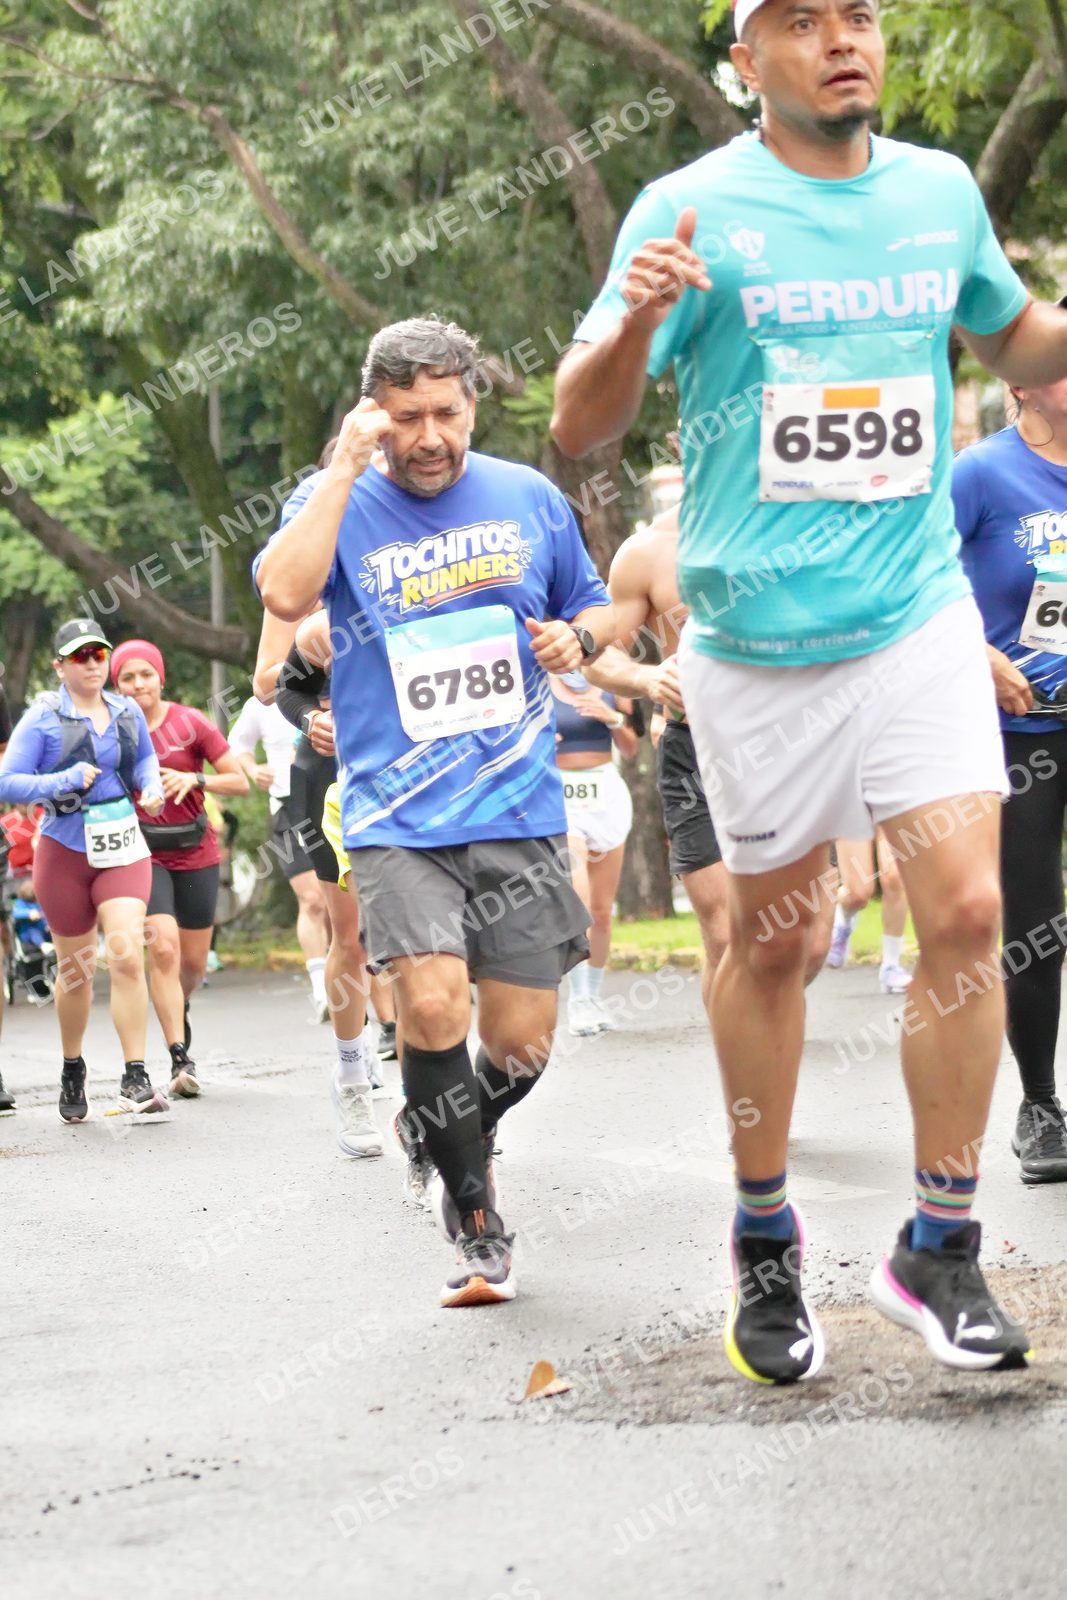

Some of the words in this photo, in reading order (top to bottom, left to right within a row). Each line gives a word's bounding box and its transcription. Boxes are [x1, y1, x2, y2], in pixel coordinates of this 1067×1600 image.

[773, 407, 923, 464] 6598
[369, 523, 521, 593] TOCHITOS
[401, 553, 521, 609] RUNNERS
[407, 658, 515, 711] 6788
[91, 825, 136, 852] 3567
